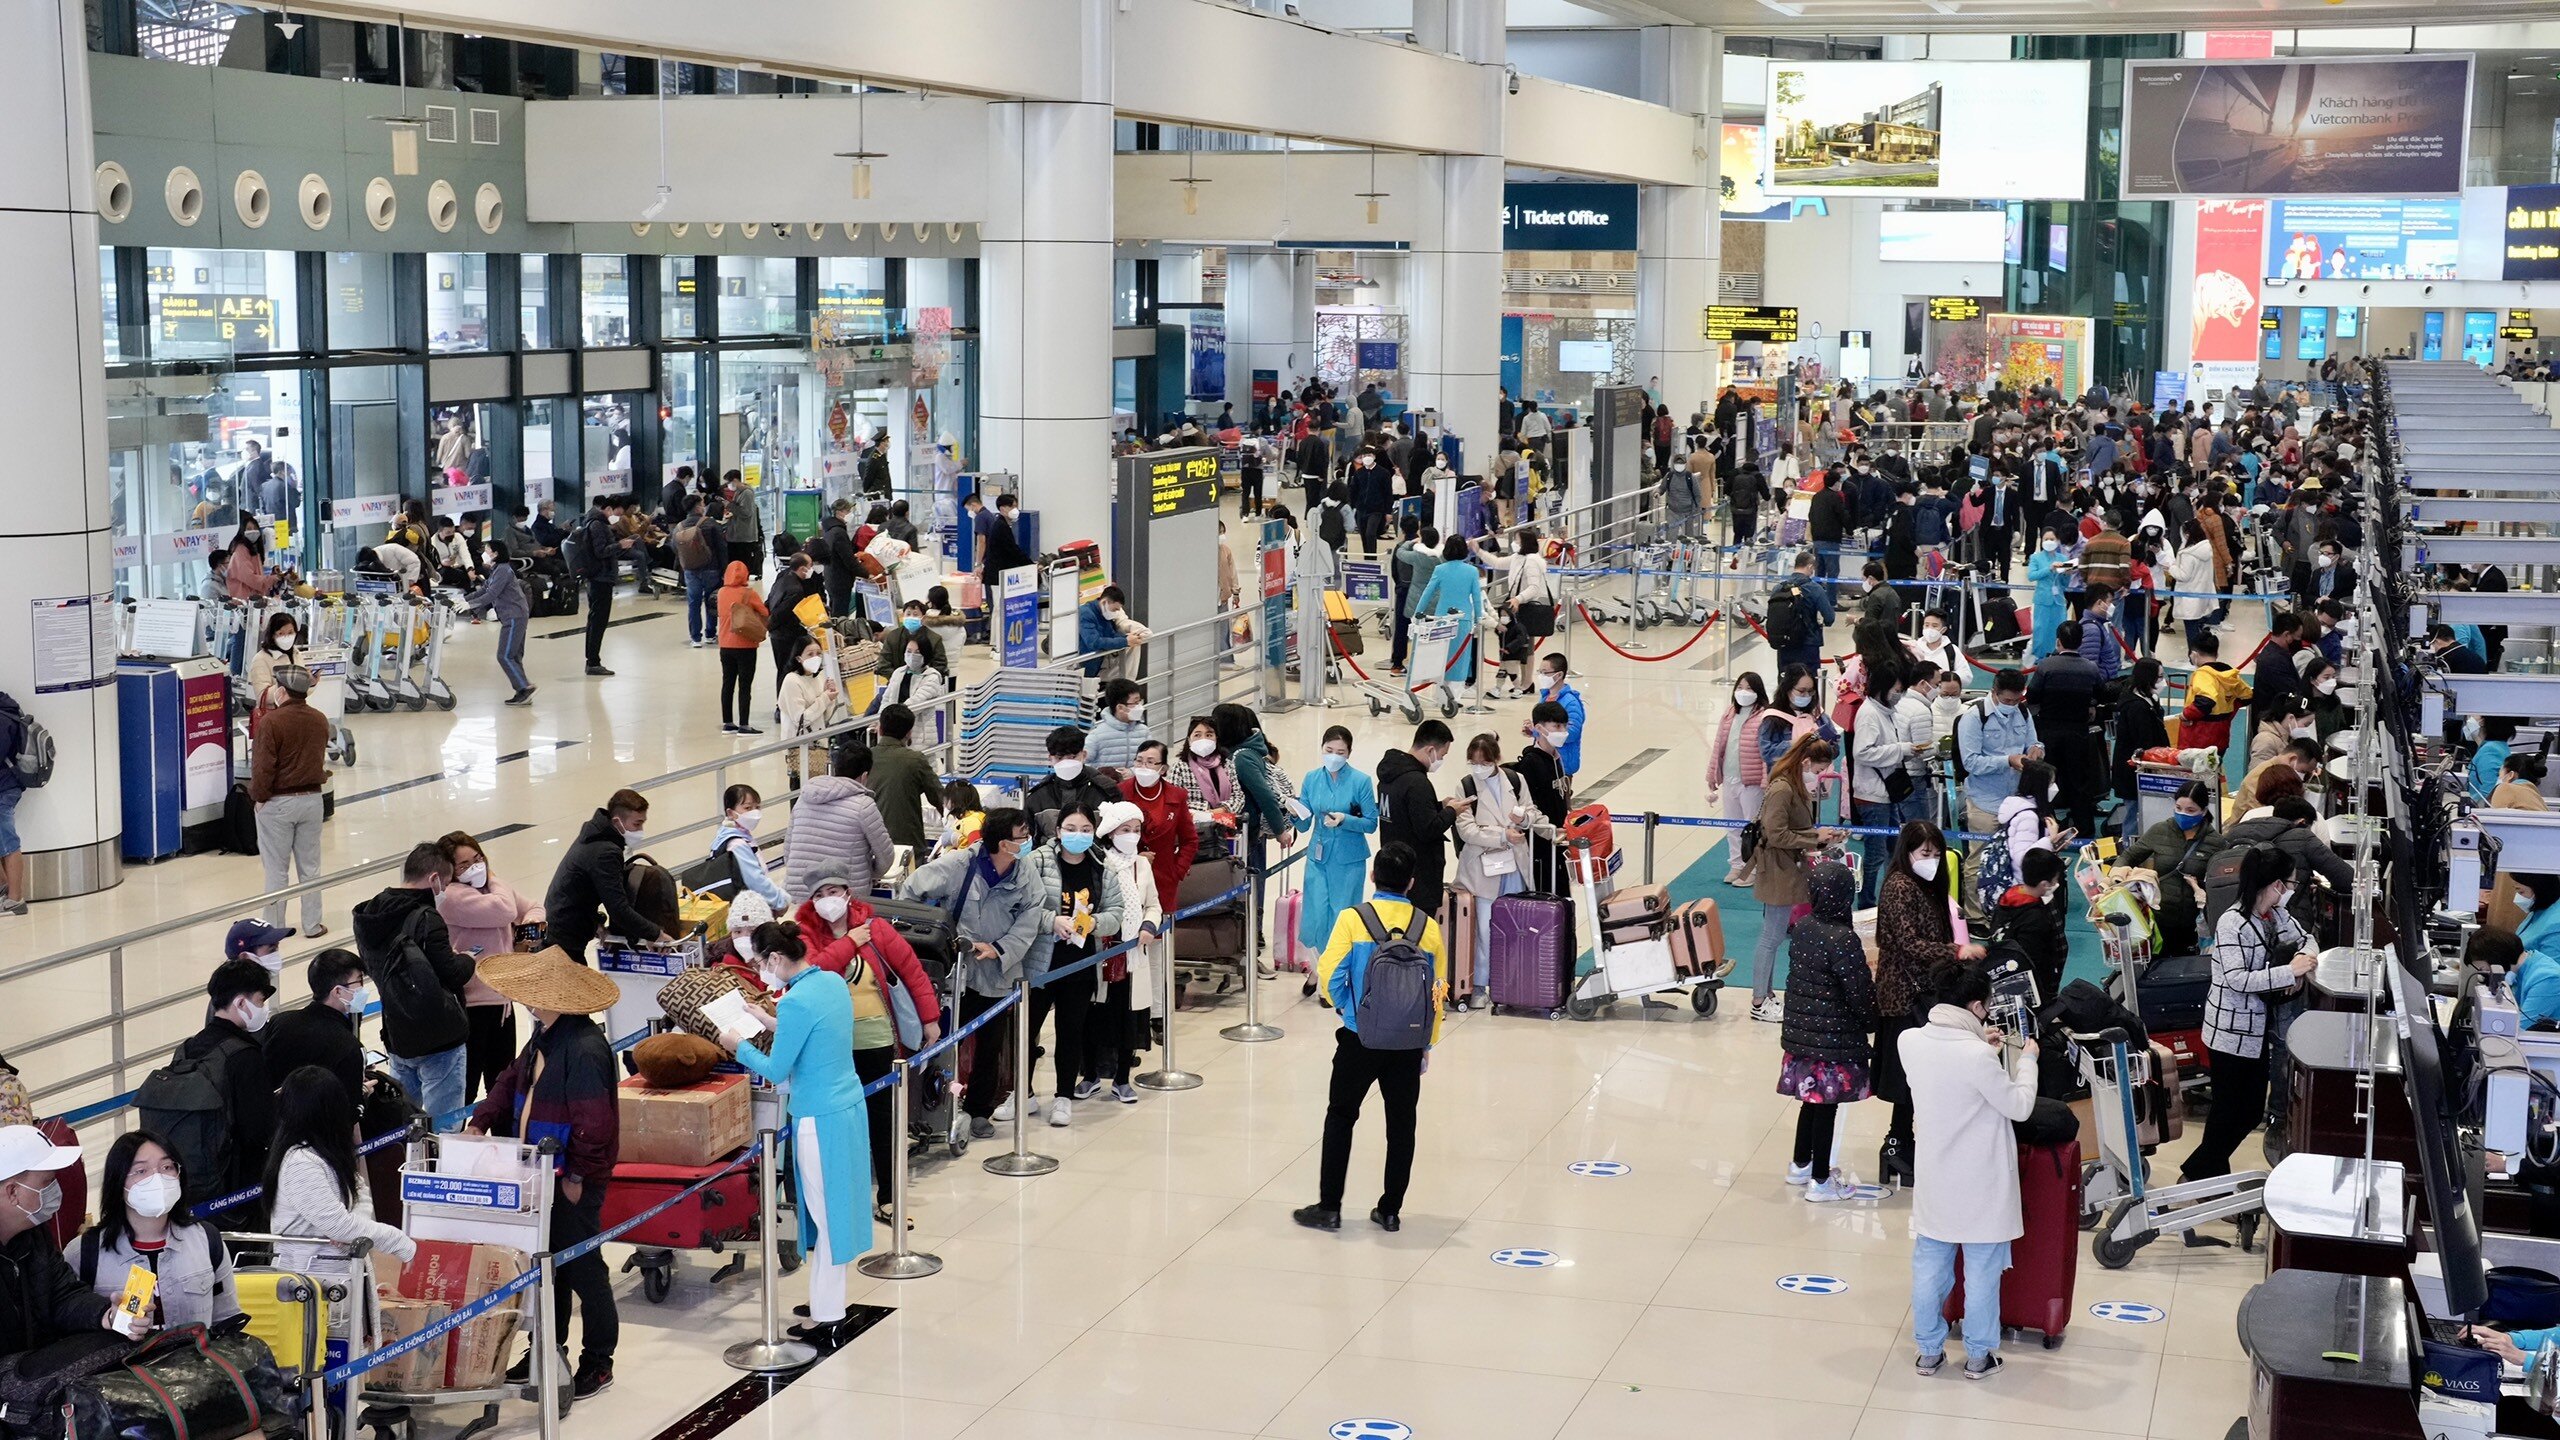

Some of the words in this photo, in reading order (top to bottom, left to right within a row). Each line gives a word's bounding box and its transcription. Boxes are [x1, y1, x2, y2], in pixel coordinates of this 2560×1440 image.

[2319, 97, 2358, 108] Khách
[2362, 97, 2393, 109] hàng
[2311, 114, 2392, 125] Vietcombank
[1522, 210, 1566, 225] Ticket
[1567, 210, 1610, 226] Office
[2508, 206, 2529, 229] CỬA
[2530, 210, 2546, 228] RA
[222, 322, 236, 339] B
[361, 501, 382, 512] VNPAY
[173, 535, 201, 549] VNPAY
[114, 545, 138, 557] VNPAY
[1007, 573, 1020, 586] NIA
[1007, 619, 1023, 646] 40
[358, 1143, 373, 1154] OIBAI
[374, 1129, 406, 1149] INTERNATIO
[439, 1180, 462, 1191] 20.000
[209, 1196, 227, 1211] CẢNG
[227, 1191, 246, 1207] HÀNG
[246, 1185, 263, 1200] KHÔN
[335, 1367, 352, 1380] N.I.A
[367, 1353, 386, 1368] CẢNG
[386, 1344, 404, 1360] HÀNG
[404, 1333, 426, 1352] KHÔNG
[426, 1323, 444, 1340] QUỐC
[444, 1316, 452, 1331] TẾ
[451, 1313, 463, 1327] NỘI
[462, 1309, 473, 1322] BÀI
[484, 1294, 498, 1306] N.I.A
[510, 1274, 530, 1291] NOIBAI
[2446, 1379, 2480, 1391] VIAGS
